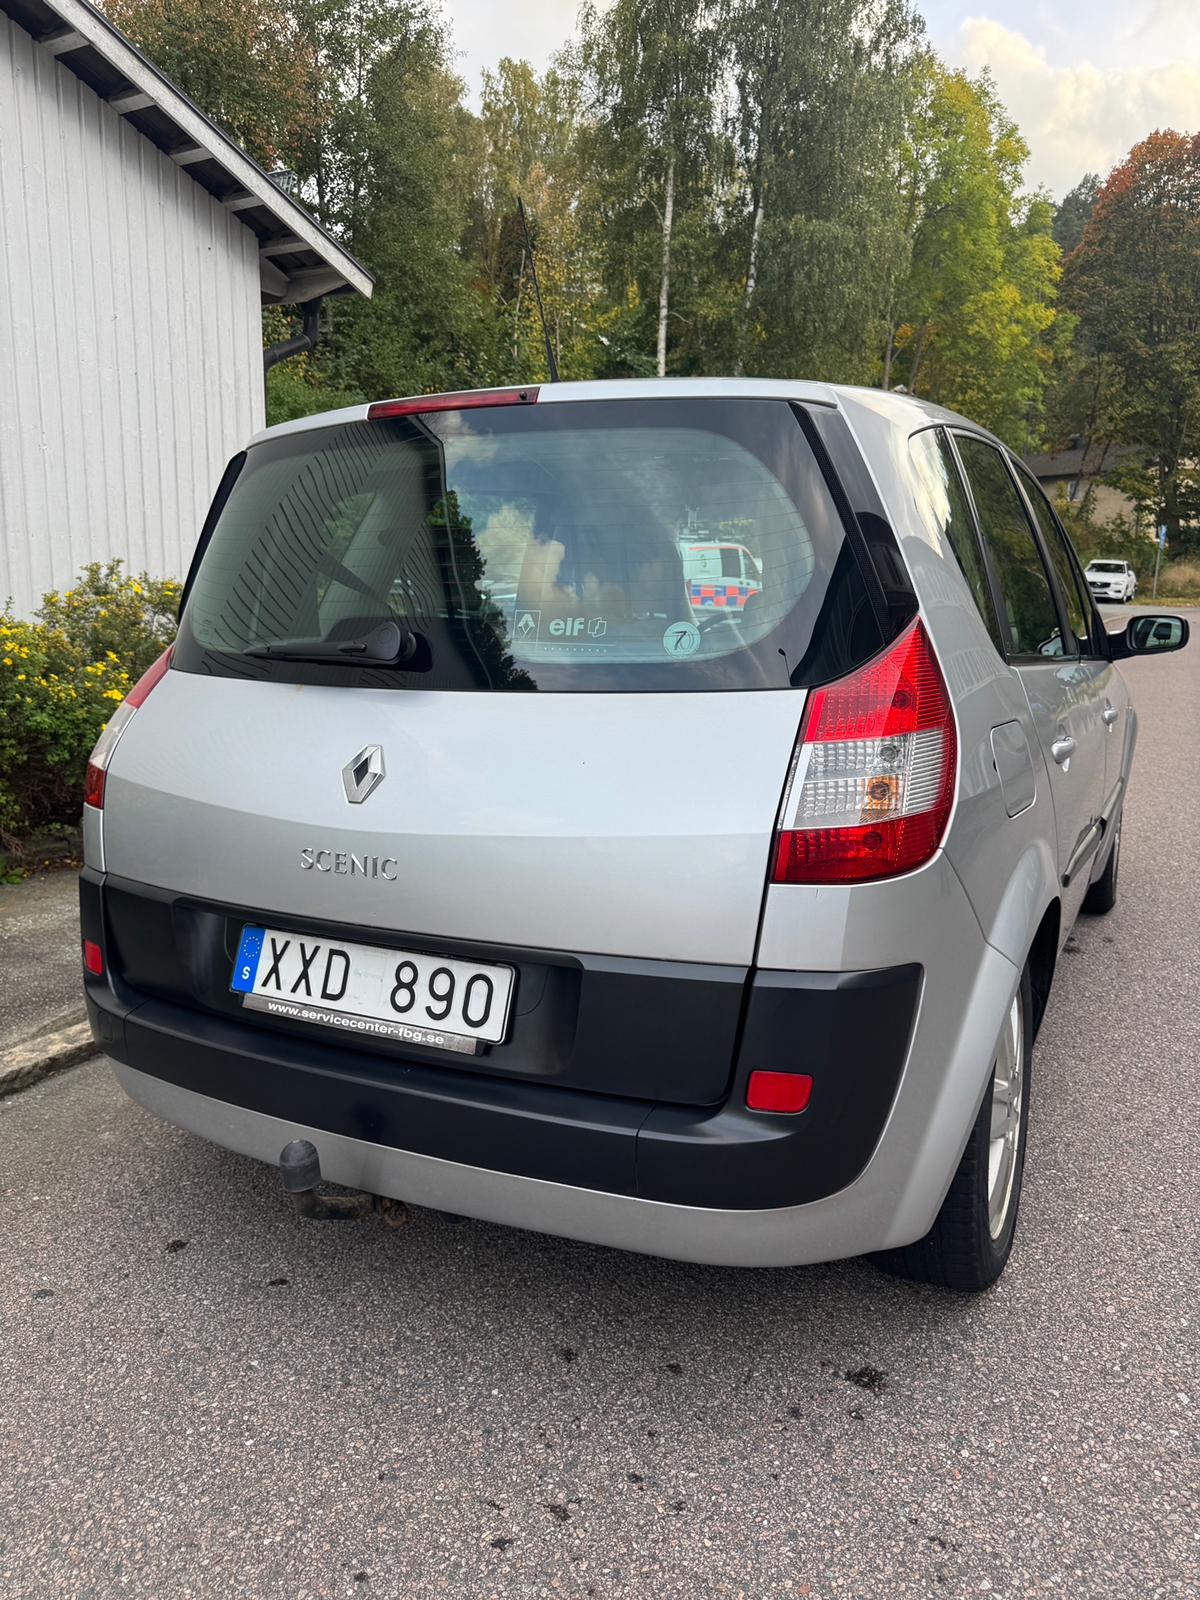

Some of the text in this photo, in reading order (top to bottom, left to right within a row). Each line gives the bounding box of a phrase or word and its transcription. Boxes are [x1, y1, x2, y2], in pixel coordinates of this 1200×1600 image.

[549, 617, 585, 636] elf
[300, 848, 398, 880] SCENIC
[241, 966, 251, 980] S
[261, 937, 494, 1028] XXD 890
[267, 1002, 445, 1045] www.servicecenter-fbg.se
